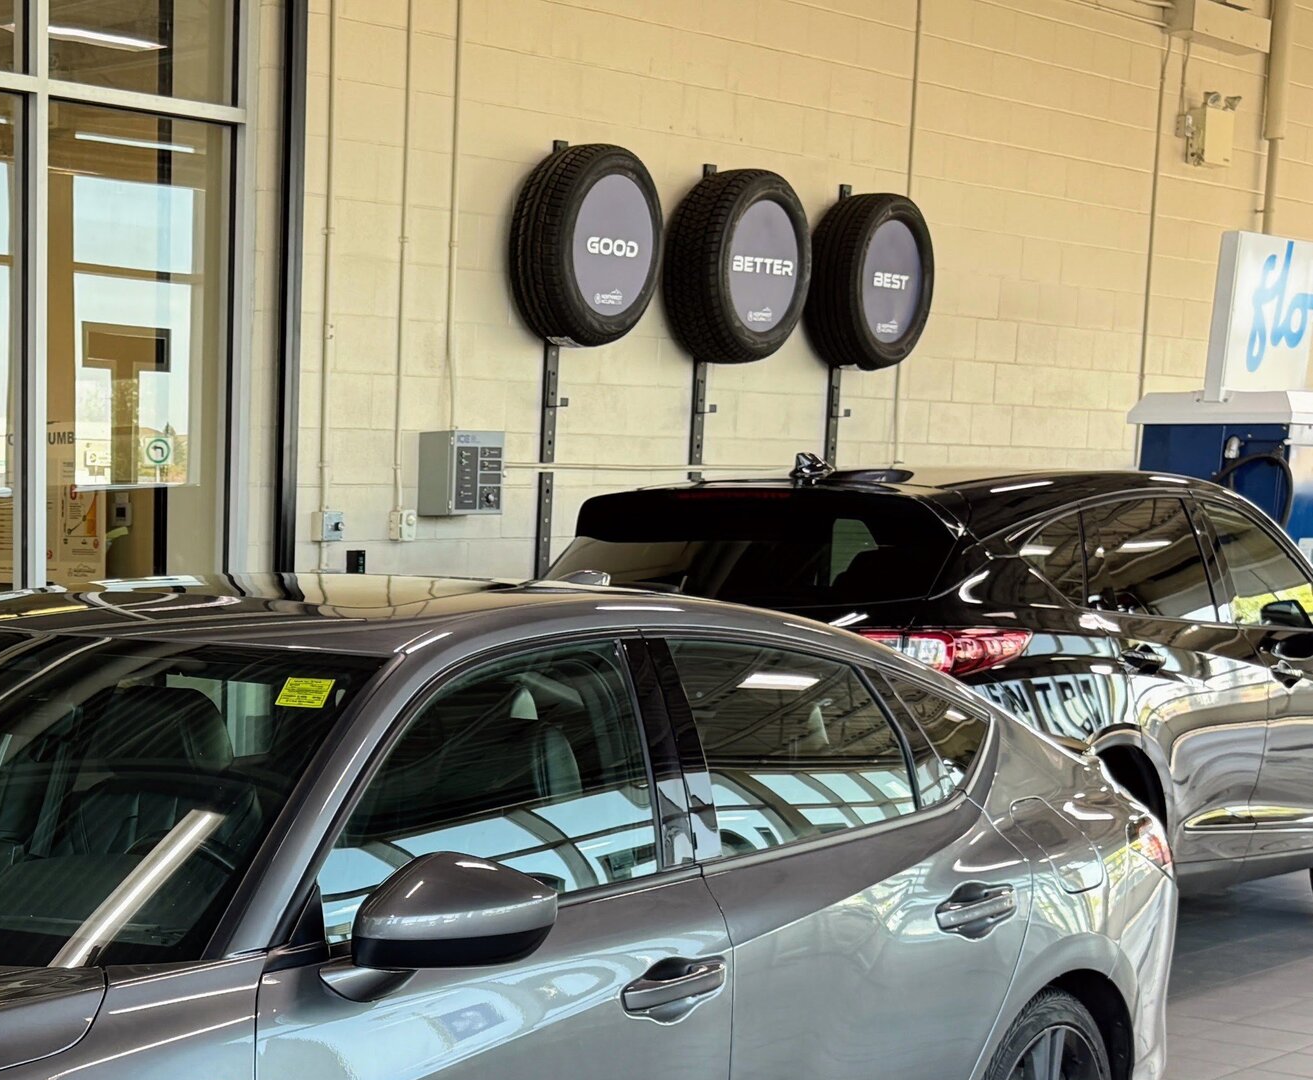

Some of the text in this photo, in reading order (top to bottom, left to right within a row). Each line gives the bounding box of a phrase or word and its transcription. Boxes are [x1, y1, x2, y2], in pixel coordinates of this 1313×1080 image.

[586, 236, 639, 258] GOOD
[732, 254, 794, 277] BETTER
[873, 271, 910, 290] BEST
[1245, 240, 1313, 373] flo
[48, 431, 75, 445] UMB
